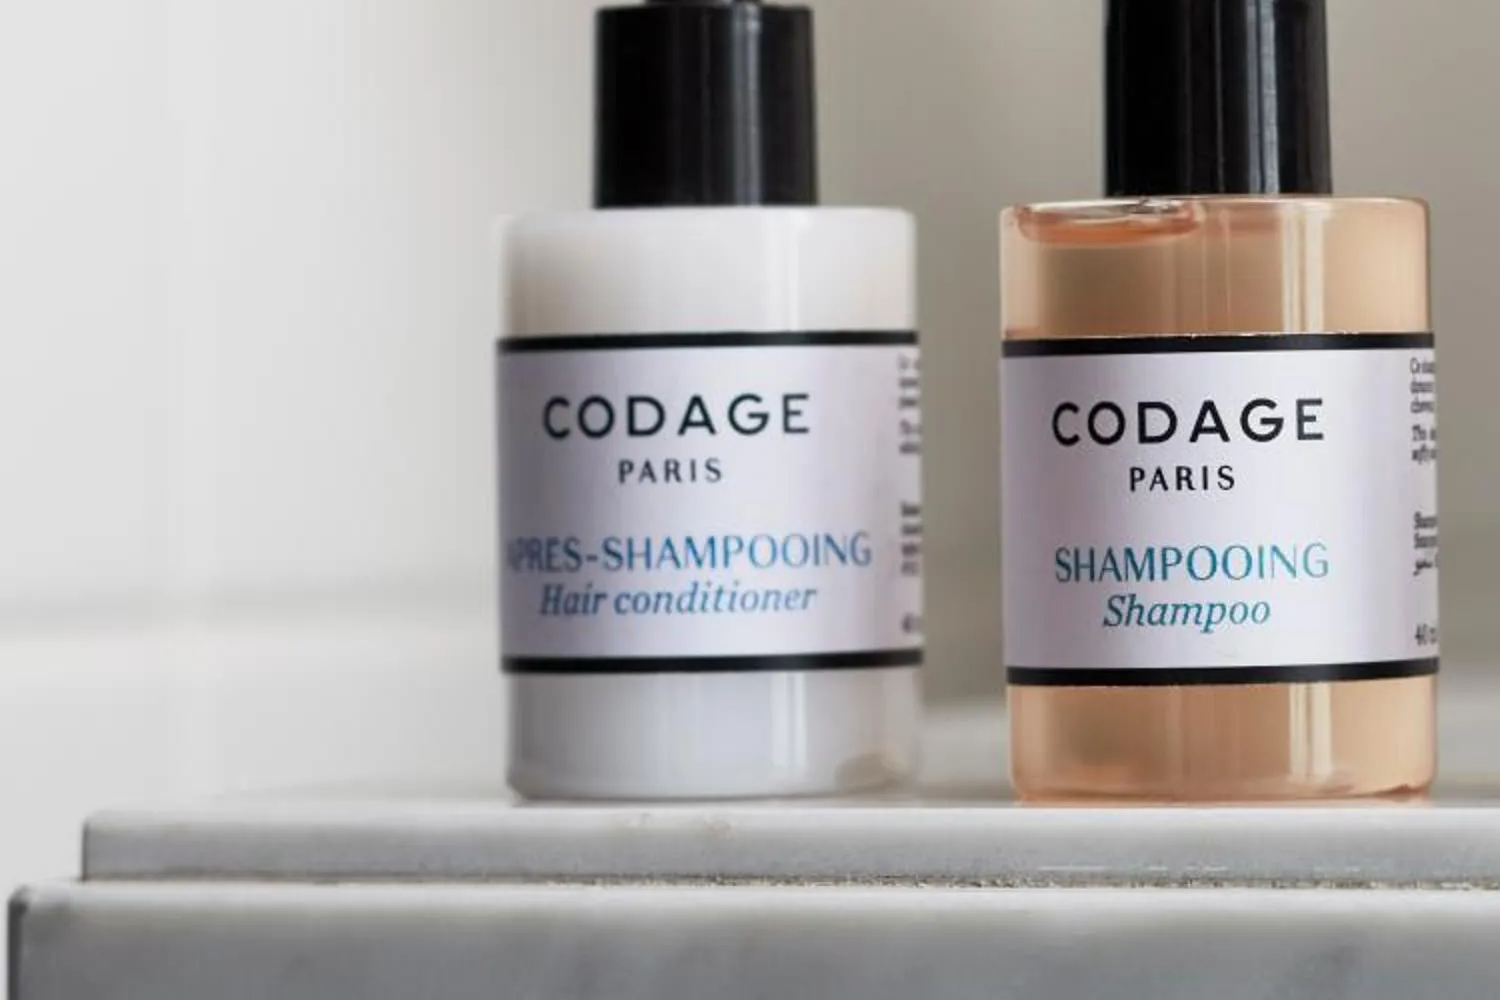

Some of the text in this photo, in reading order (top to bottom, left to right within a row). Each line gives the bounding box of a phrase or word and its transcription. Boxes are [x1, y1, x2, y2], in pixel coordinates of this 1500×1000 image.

[543, 393, 811, 441] CODAGE
[1053, 399, 1325, 448] CODAGE
[619, 458, 724, 485] PARIS
[1130, 466, 1236, 493] PARIS
[1056, 543, 1329, 584] SHAMPOOING
[539, 580, 819, 617] Hair conditioner
[1104, 595, 1272, 635] Shampoo
